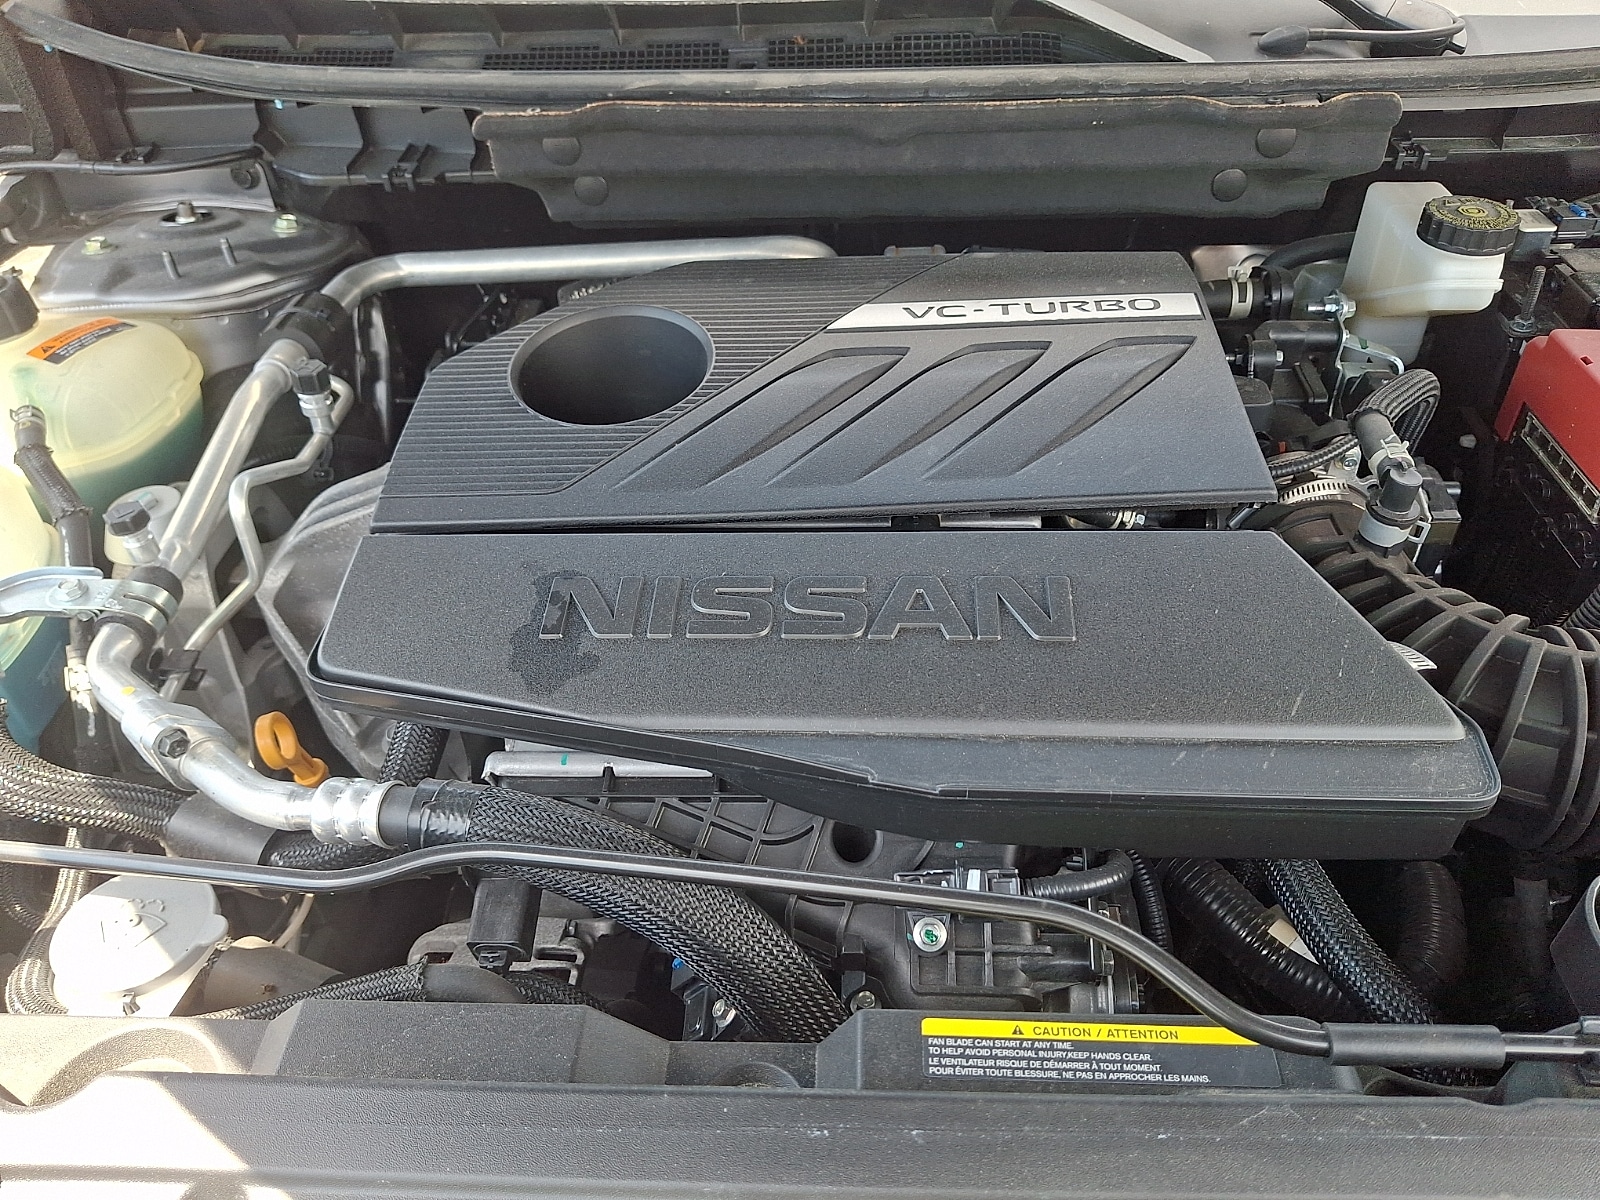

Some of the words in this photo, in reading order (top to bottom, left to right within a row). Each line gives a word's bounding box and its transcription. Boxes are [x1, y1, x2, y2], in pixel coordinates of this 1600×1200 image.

[902, 298, 1162, 319] VC-TURBO
[538, 575, 1077, 642] NISSAN
[1033, 1026, 1091, 1037] CAUTION
[1096, 1028, 1102, 1037] /
[1107, 1028, 1179, 1040] ATTENTION
[928, 1037, 944, 1046] FAN
[946, 1038, 973, 1047] BLADE
[975, 1039, 993, 1047] CAN
[994, 1039, 1020, 1048] START
[1022, 1040, 1032, 1048] AT
[1034, 1041, 1051, 1049] ANY
[1052, 1041, 1074, 1050] TIME.
[928, 1046, 940, 1055] TO
[942, 1047, 964, 1055] HELP
[965, 1048, 990, 1056] AVOID
[992, 1049, 1037, 1058] PERSONAL
[1091, 1052, 1121, 1060] HANDS
[1123, 1052, 1153, 1061] CLEAR.
[928, 1057, 939, 1065] LE
[940, 1057, 995, 1067] VENTILATEUR
[996, 1059, 1028, 1068] RISQUE
[1030, 1060, 1042, 1068] DE
[1043, 1059, 1090, 1069] DÉMARRER
[1092, 1060, 1098, 1070] À
[1099, 1062, 1122, 1071] TOUT
[1123, 1063, 1163, 1072] MOMENT.
[929, 1066, 954, 1075] POUR
[955, 1065, 984, 1076] ÉVITER
[985, 1068, 1013, 1077] TOUTE
[1014, 1069, 1061, 1079] BLESSURE,
[1076, 1071, 1093, 1079] PAS
[1108, 1072, 1162, 1081] APPROCHER
[1163, 1073, 1180, 1082] LES
[1181, 1074, 1211, 1083] MAINS.
